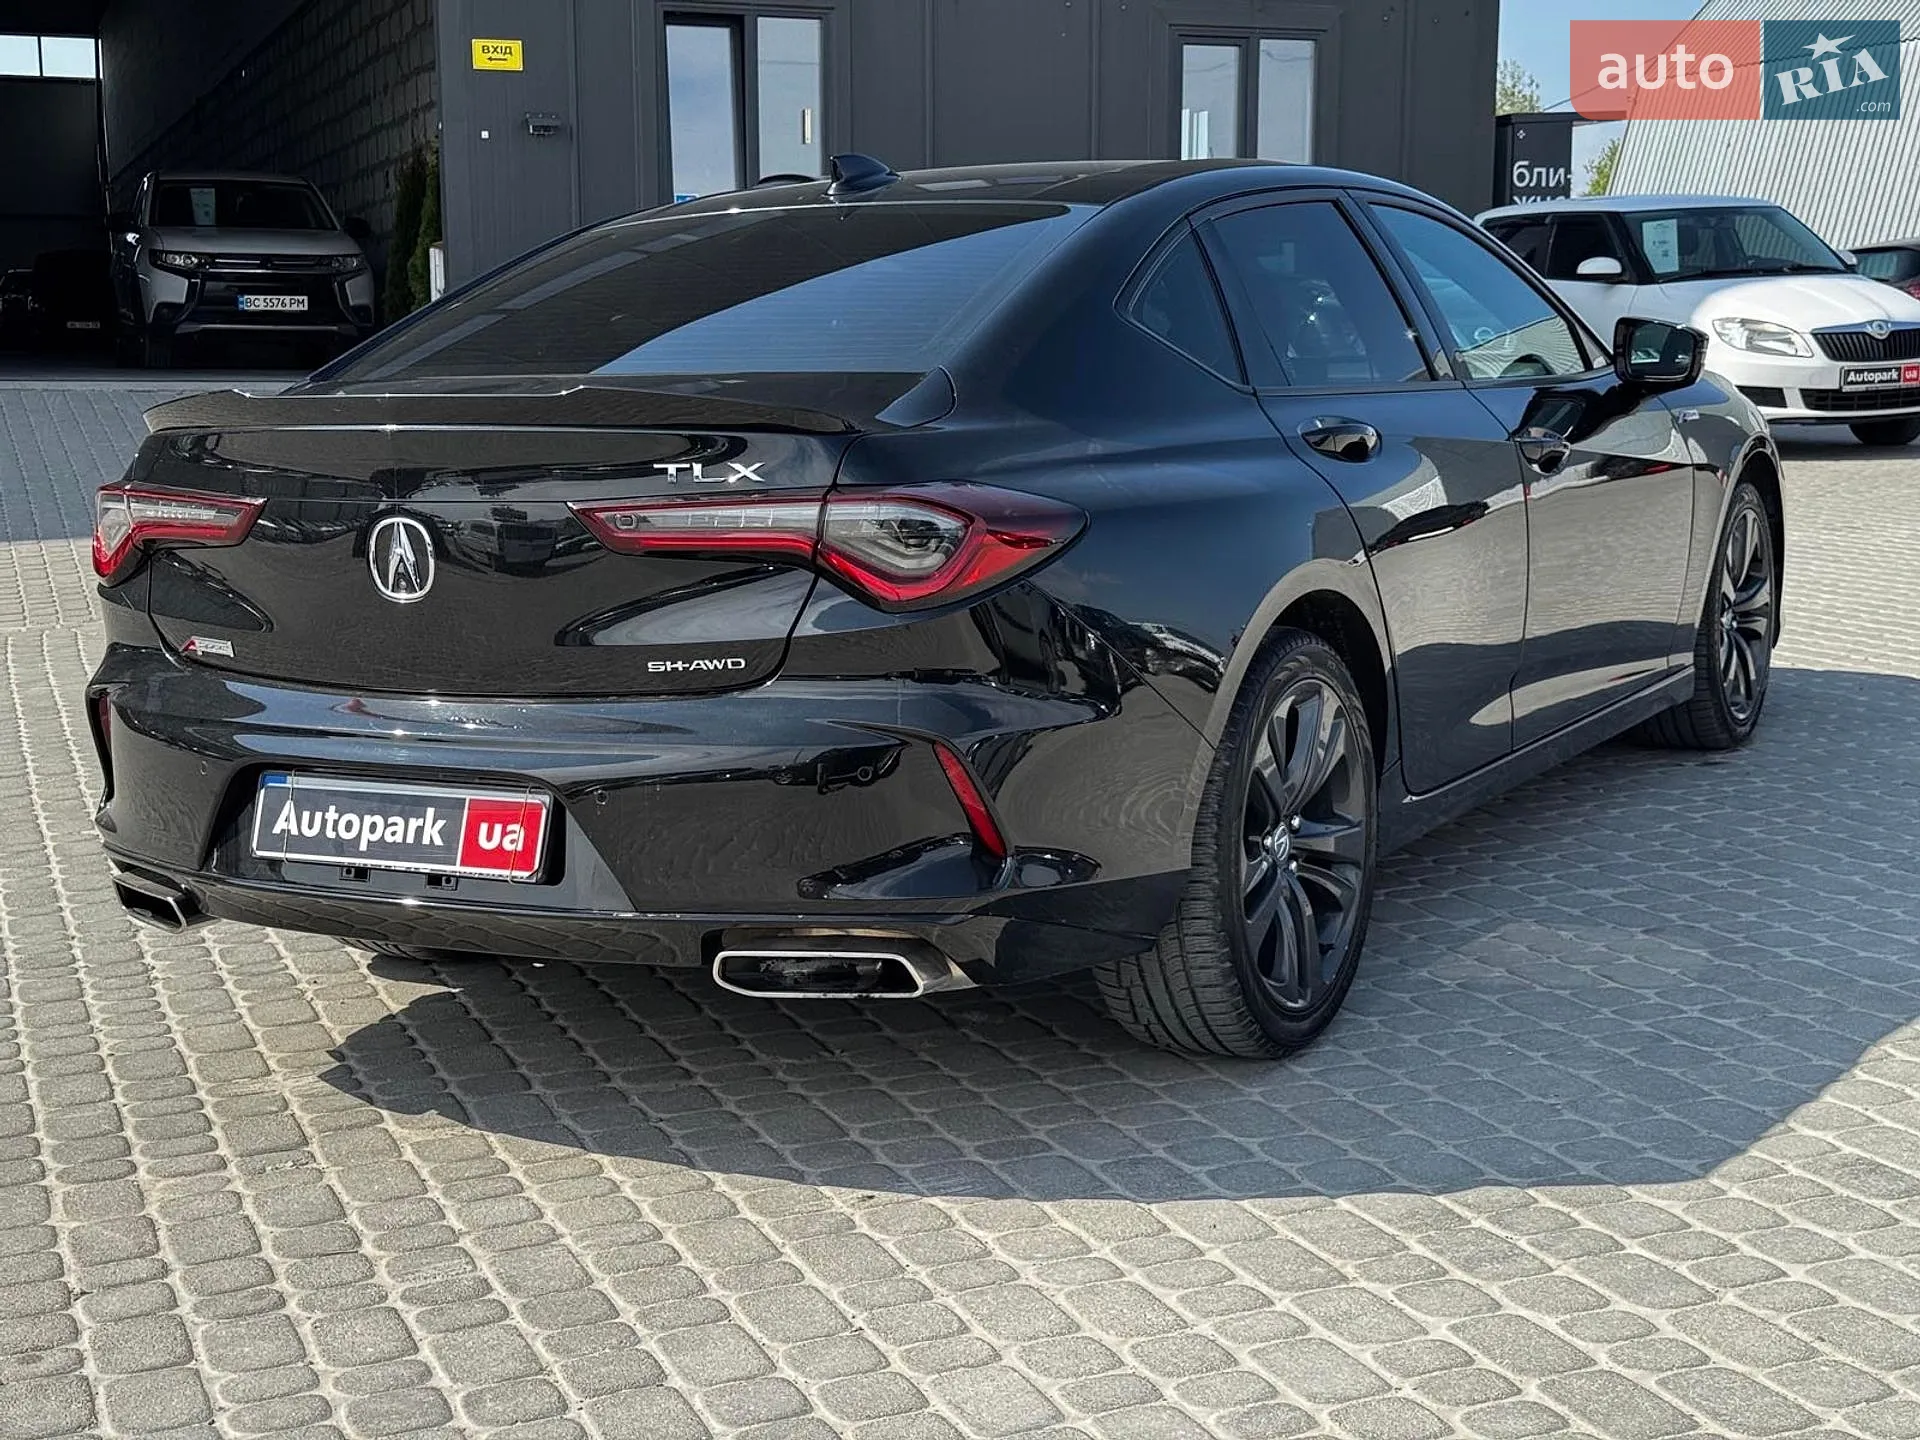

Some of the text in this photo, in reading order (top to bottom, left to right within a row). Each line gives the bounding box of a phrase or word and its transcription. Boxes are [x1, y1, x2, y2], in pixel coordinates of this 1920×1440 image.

[481, 44, 513, 56] ВХІД
[245, 297, 305, 308] BC 5576 PM
[1847, 368, 1918, 383] Autopark ua
[653, 462, 766, 483] TLX
[647, 658, 745, 672] SH-AWD
[272, 800, 526, 852] Autopark ua
